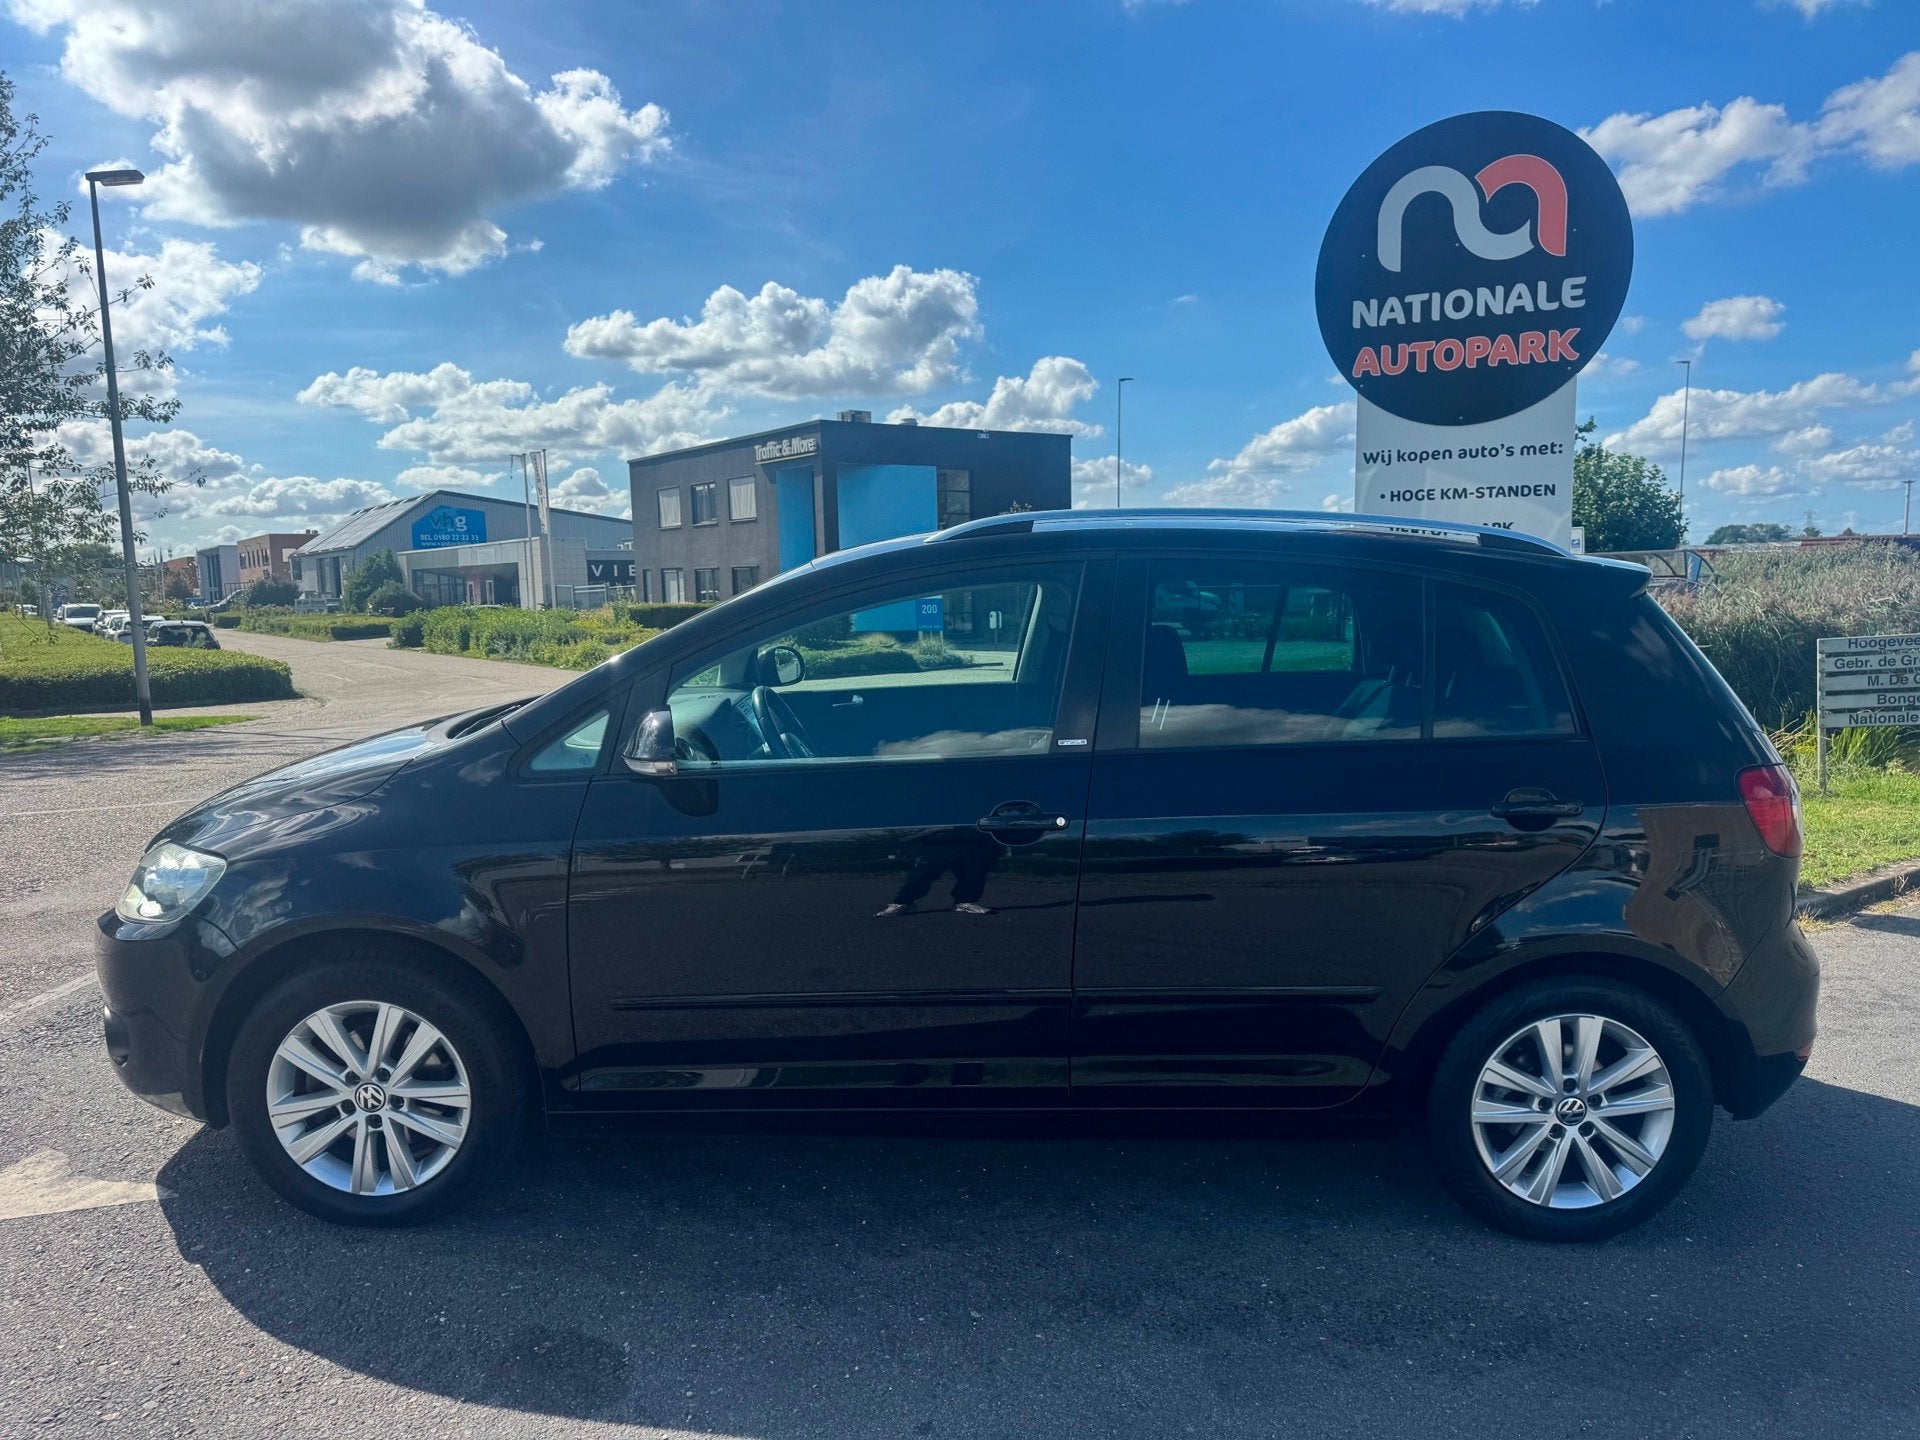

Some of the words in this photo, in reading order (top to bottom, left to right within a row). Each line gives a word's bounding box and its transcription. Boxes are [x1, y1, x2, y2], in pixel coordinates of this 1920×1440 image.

[1352, 276, 1587, 329] NATIONALE
[1352, 327, 1582, 378] AUTOPARK
[754, 441, 782, 461] Traffic
[792, 437, 817, 454] More
[1363, 450, 1392, 467] Wij
[1397, 448, 1453, 464] kopen
[1458, 443, 1515, 459] auto's
[1520, 441, 1564, 456] met:
[1390, 488, 1436, 502] HOGE
[1440, 484, 1556, 500] KM-STANDEN
[921, 604, 938, 614] 200
[1834, 658, 1873, 670] Gebr.
[1878, 655, 1897, 667] de
[1900, 654, 1920, 666] Gr
[1867, 675, 1884, 687] M.
[1889, 674, 1909, 685] De
[1848, 711, 1919, 725] Nationale
